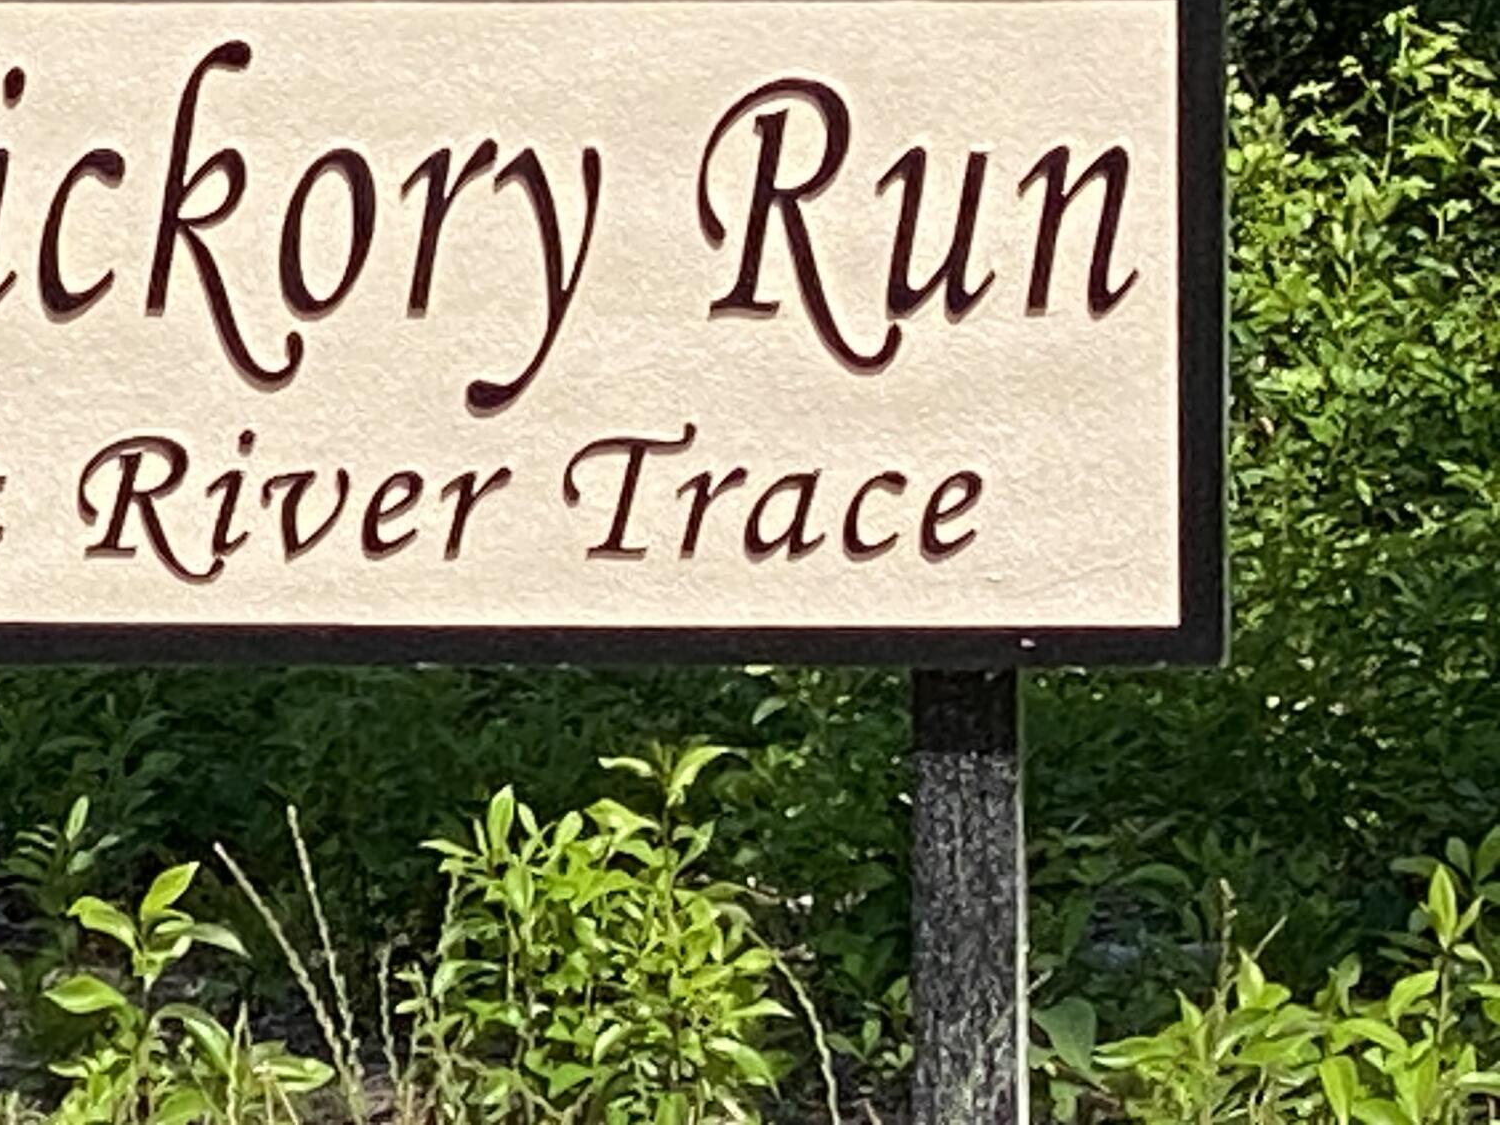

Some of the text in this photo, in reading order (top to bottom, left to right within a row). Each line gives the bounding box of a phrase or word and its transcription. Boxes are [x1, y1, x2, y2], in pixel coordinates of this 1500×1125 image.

[696, 78, 1140, 371] Run
[77, 429, 512, 583] River
[562, 422, 984, 561] Trace
